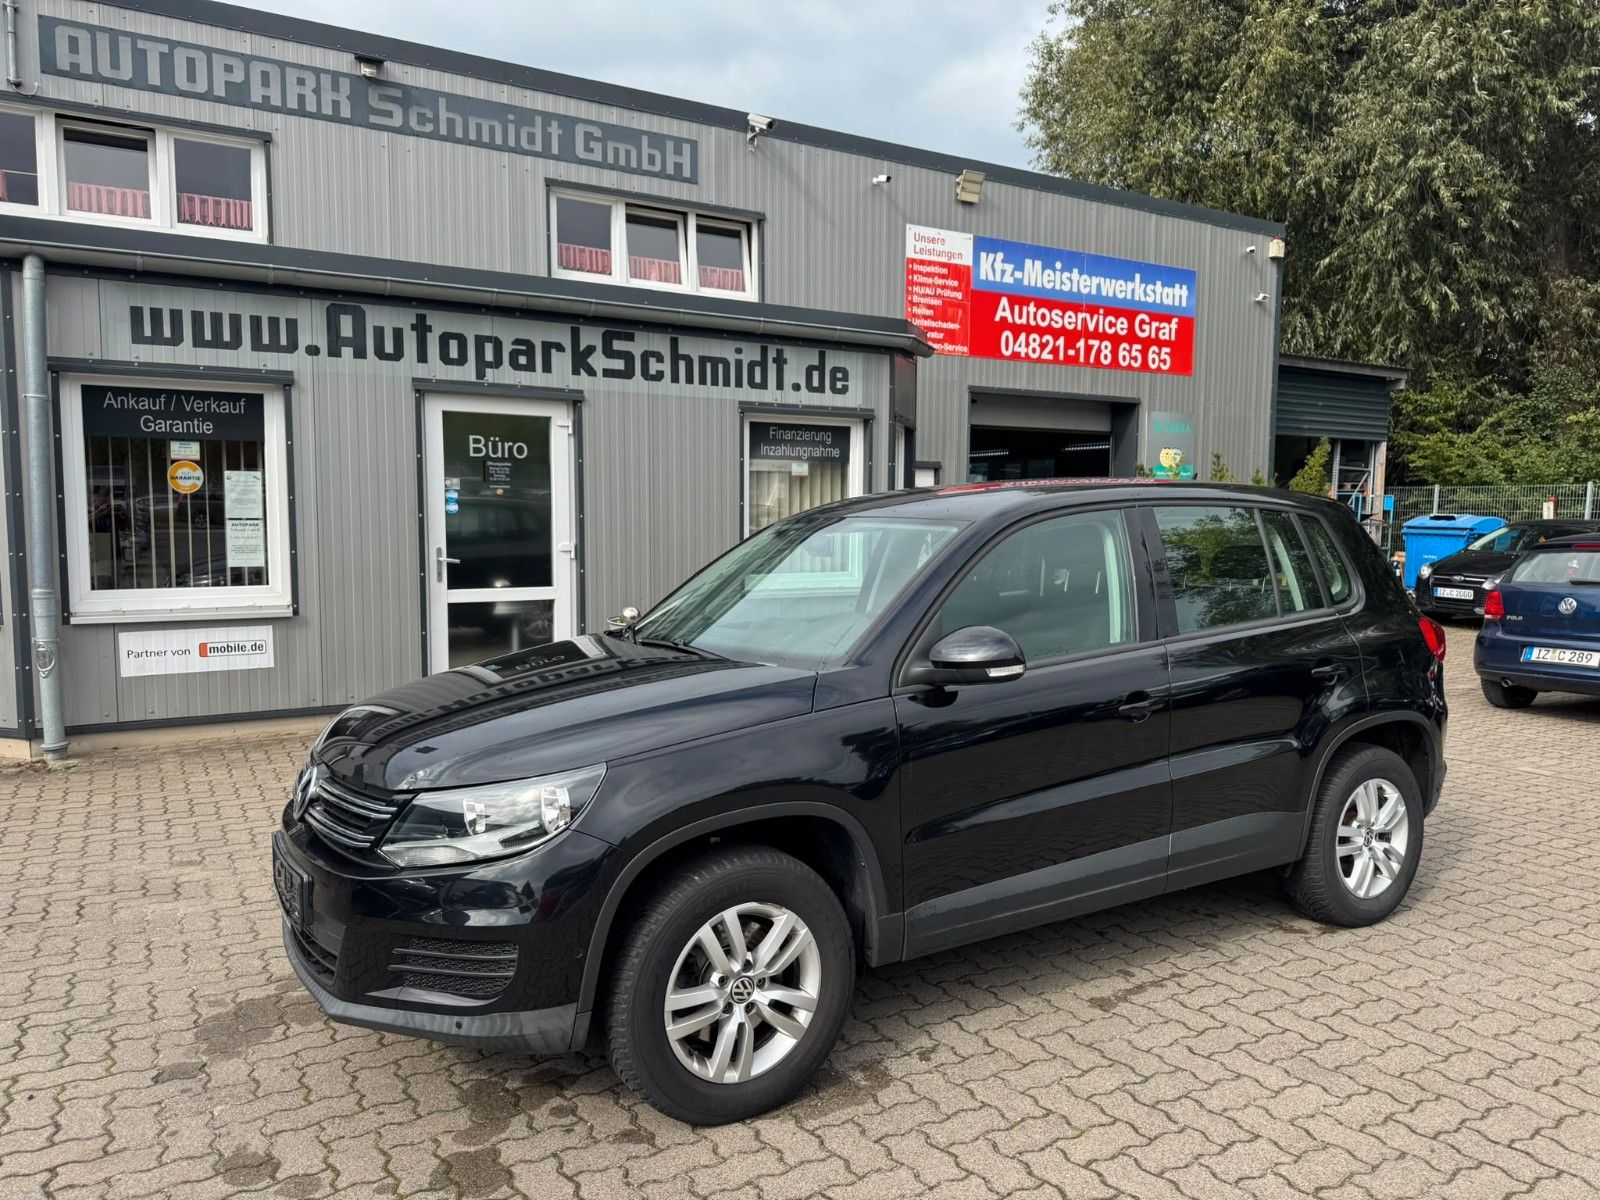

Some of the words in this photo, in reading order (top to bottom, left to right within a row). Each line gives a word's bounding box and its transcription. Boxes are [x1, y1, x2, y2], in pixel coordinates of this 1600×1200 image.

[54, 24, 350, 118] AUTOPARK
[367, 84, 562, 156] Schmidt
[575, 123, 691, 178] GmbH
[914, 232, 945, 246] Unsere
[914, 245, 963, 261] Leistungen
[913, 263, 948, 275] Inspektion
[913, 274, 959, 287] Klima-Service
[979, 251, 1188, 307] Kfz-Meisterwerkstatt
[912, 295, 943, 306] Bremsen
[936, 288, 963, 300] Prüfung
[912, 306, 934, 316] Reifen
[994, 297, 1128, 335] Autoservice
[1134, 313, 1179, 341] Graf
[129, 302, 850, 395] www.AutoparkSchmidt.de
[1000, 330, 1112, 365] 04821-178
[1118, 343, 1142, 368] 65
[1147, 346, 1171, 371] 65
[103, 391, 166, 410] Ankauf
[170, 394, 177, 411] /
[181, 395, 246, 414] Verkauf
[140, 415, 213, 434] Garantie
[769, 427, 832, 445] Finanzierung
[469, 435, 528, 459] Büro
[760, 443, 840, 459] Inzahlungnahme
[127, 650, 168, 659] Partner
[171, 649, 191, 657] von
[208, 642, 264, 655] mobile.de
[1535, 649, 1551, 660] IZ
[1557, 650, 1566, 661] C
[1568, 651, 1593, 664] 289
